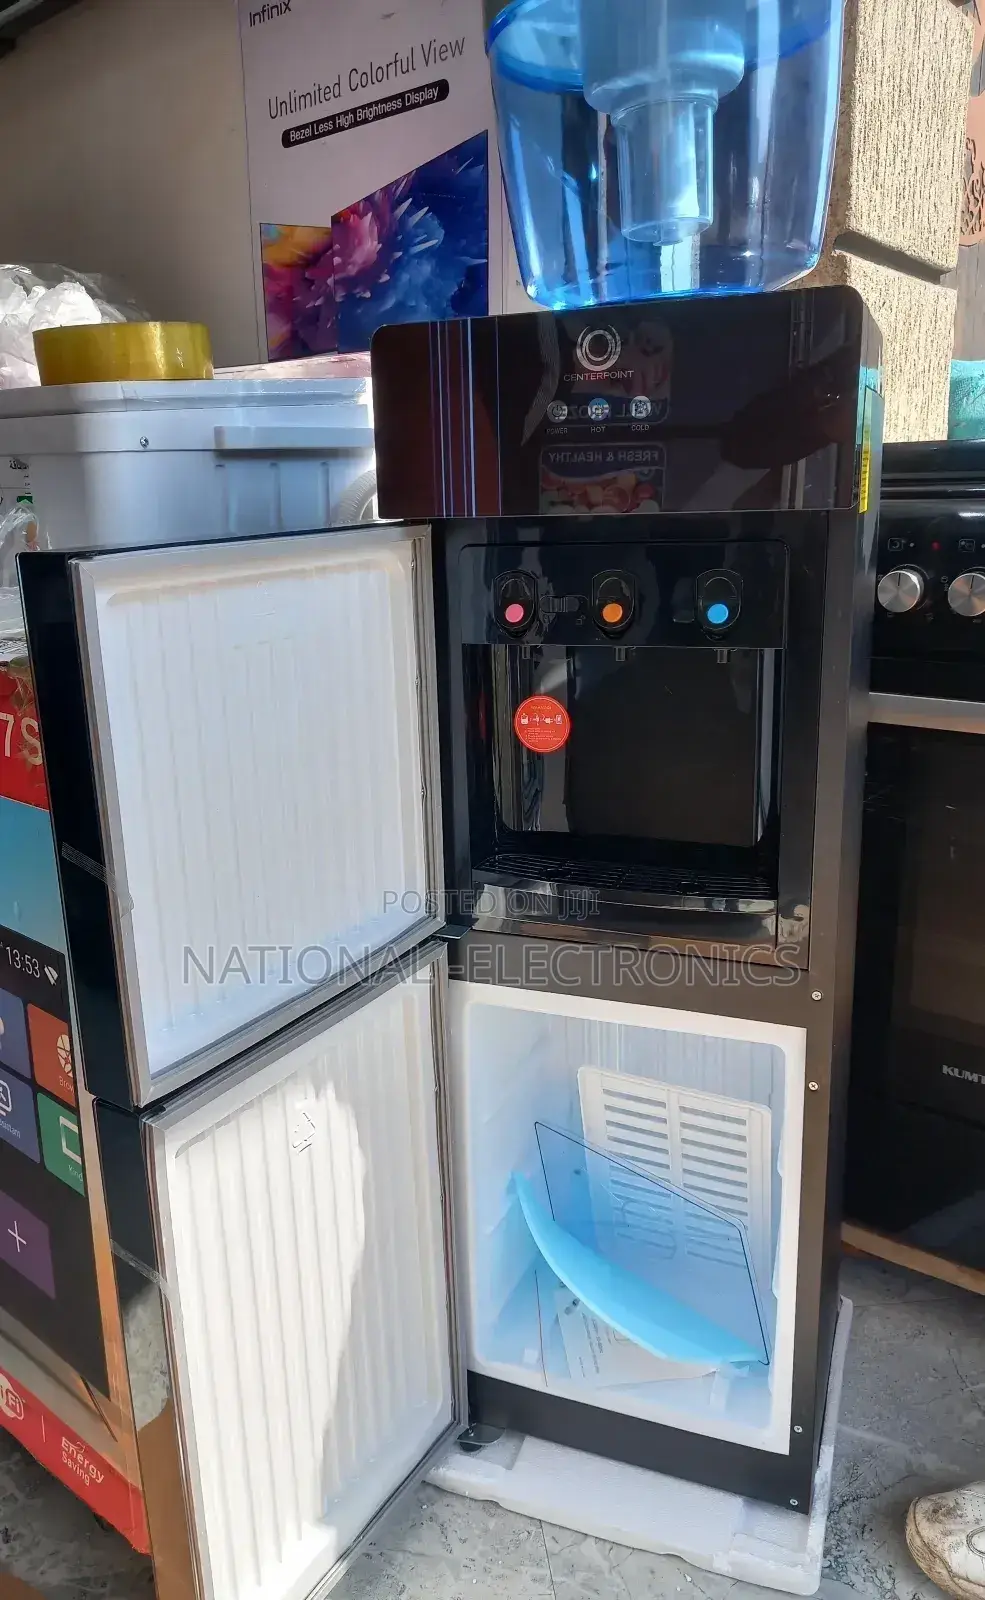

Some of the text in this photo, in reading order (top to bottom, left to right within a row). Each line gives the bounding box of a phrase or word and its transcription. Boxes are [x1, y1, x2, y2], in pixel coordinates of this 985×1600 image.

[249, 0, 292, 27] Infinix
[268, 37, 466, 119] Unlimited Colorful View
[290, 86, 440, 142] Bezel Less High Brightness Display
[563, 370, 634, 382] CENTERPOINT
[631, 424, 650, 432] COLD
[5, 946, 40, 978] 13:53
[61, 1437, 105, 1483] Energy
[61, 1452, 91, 1486] Saving
